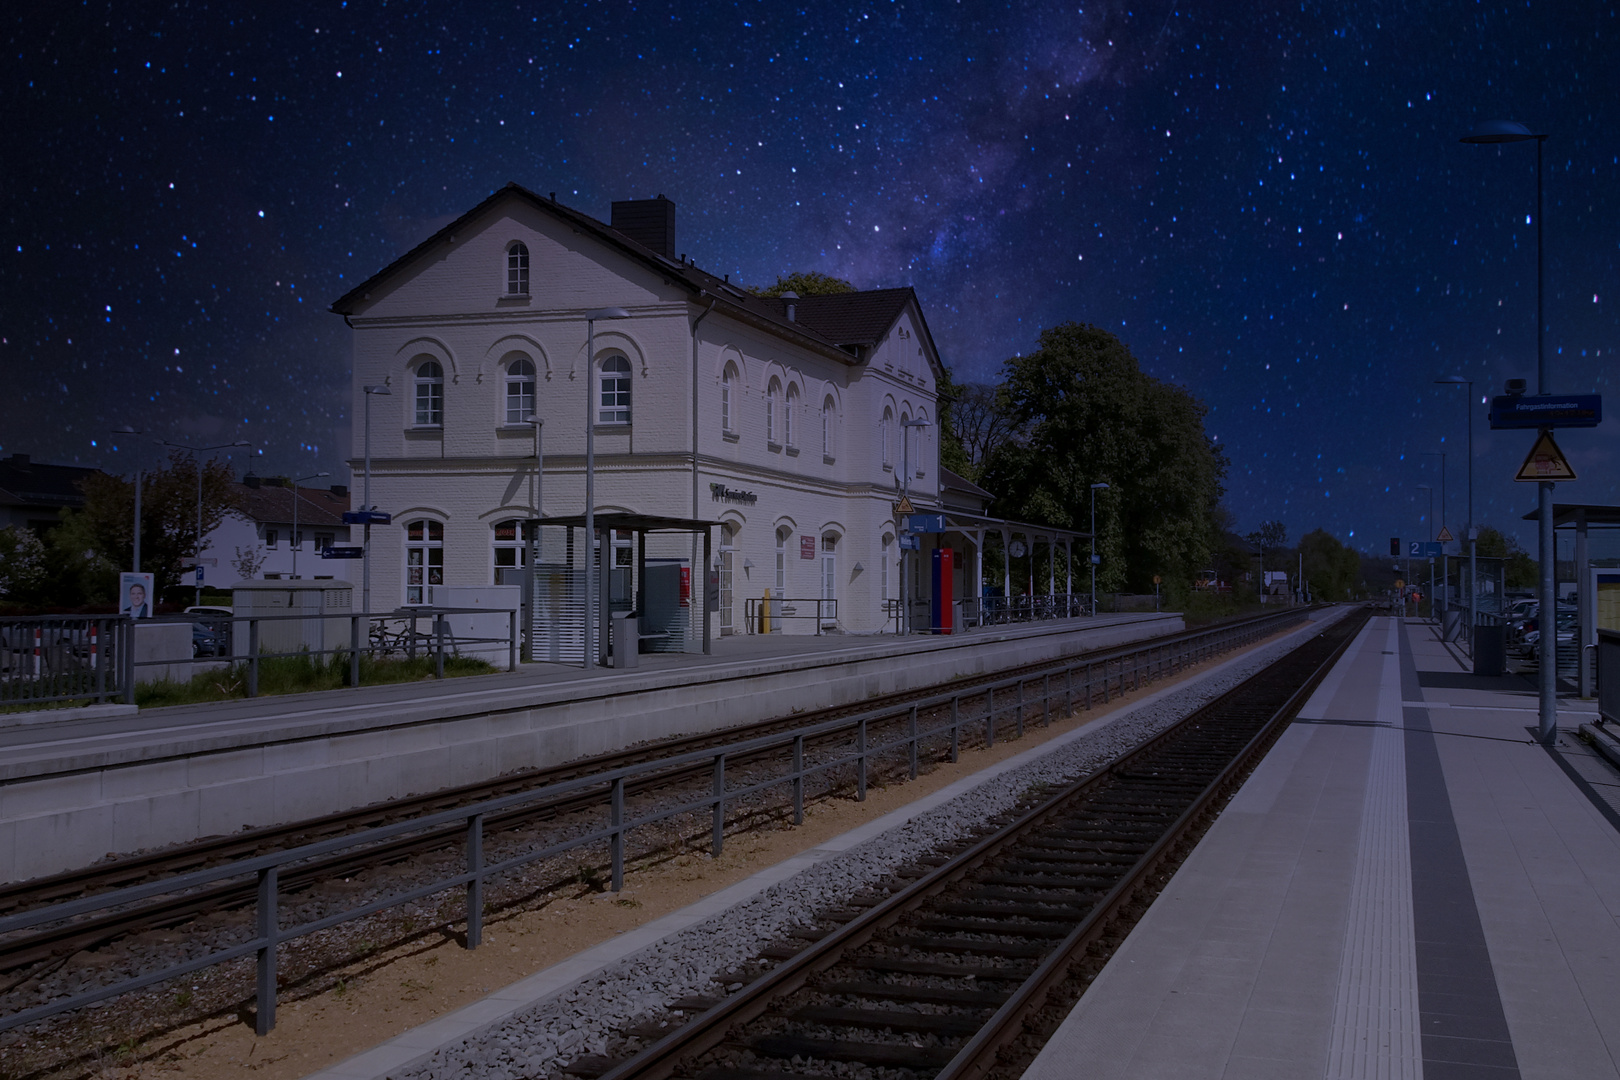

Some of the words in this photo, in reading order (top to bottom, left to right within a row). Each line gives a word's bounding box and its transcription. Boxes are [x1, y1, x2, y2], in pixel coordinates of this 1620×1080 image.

[1516, 402, 1578, 411] Fahrgastinformation
[936, 515, 943, 529] 1
[1410, 542, 1420, 555] 2
[197, 567, 203, 579] P
